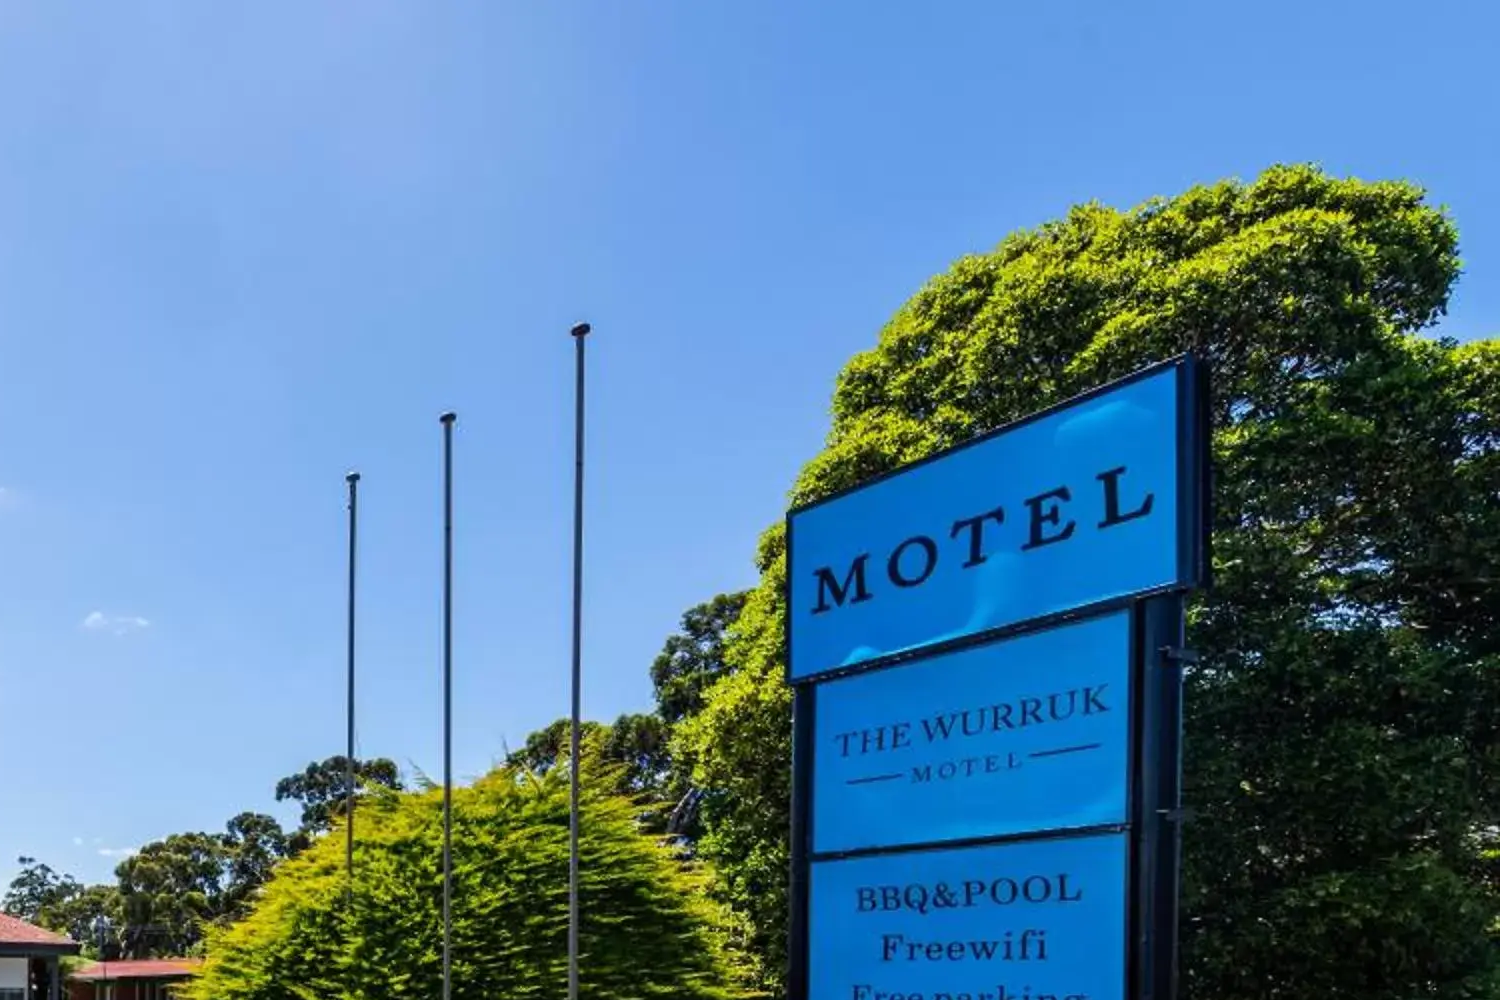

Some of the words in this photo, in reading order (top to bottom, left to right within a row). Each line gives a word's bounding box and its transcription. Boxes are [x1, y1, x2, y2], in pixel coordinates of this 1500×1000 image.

[810, 465, 1155, 615] MOTEL
[834, 721, 912, 758] THE
[920, 683, 1112, 741] WURRUK
[910, 751, 1024, 784] MOTEL
[855, 873, 1083, 915] BBQ&POOL
[880, 930, 1048, 962] Freewifi
